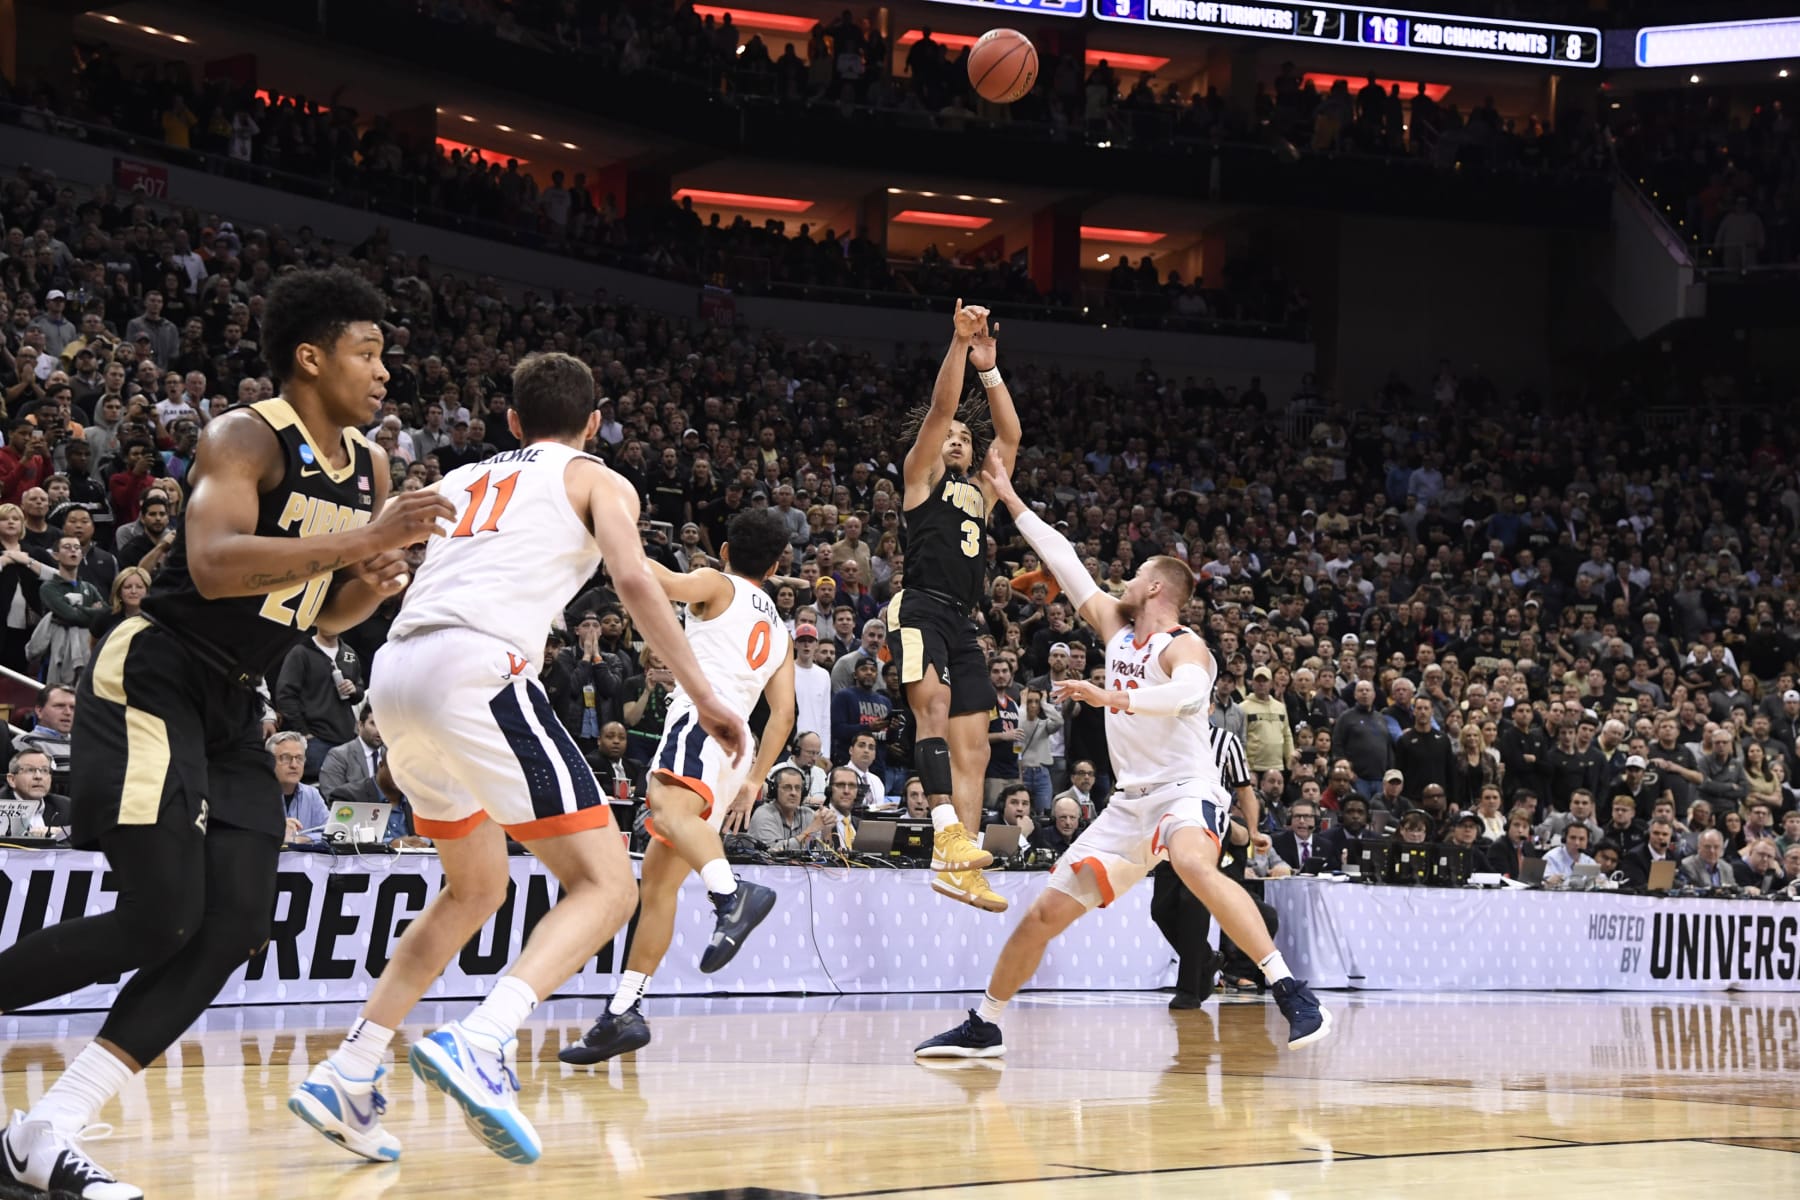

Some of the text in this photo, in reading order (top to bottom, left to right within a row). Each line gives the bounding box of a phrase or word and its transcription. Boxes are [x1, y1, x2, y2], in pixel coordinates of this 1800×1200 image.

[1150, 0, 1196, 19] POINTS
[1197, 2, 1219, 22] OFF
[1220, 4, 1293, 30] TURNOVERS
[1312, 10, 1327, 36] 7
[1369, 16, 1399, 43] 16
[1413, 23, 1443, 44] 2ND
[1443, 26, 1498, 49] CHANCE
[1498, 31, 1548, 54] POINTS
[1566, 34, 1582, 60] 8
[450, 470, 521, 538] 11
[960, 519, 980, 558] 3
[259, 571, 334, 632] 20
[752, 593, 778, 629] CLARK
[746, 620, 771, 671] 0
[859, 700, 888, 719] HARD
[1588, 914, 1645, 942] HOSTED
[1650, 912, 1800, 980] UNIVERS
[1620, 947, 1642, 974] BY
